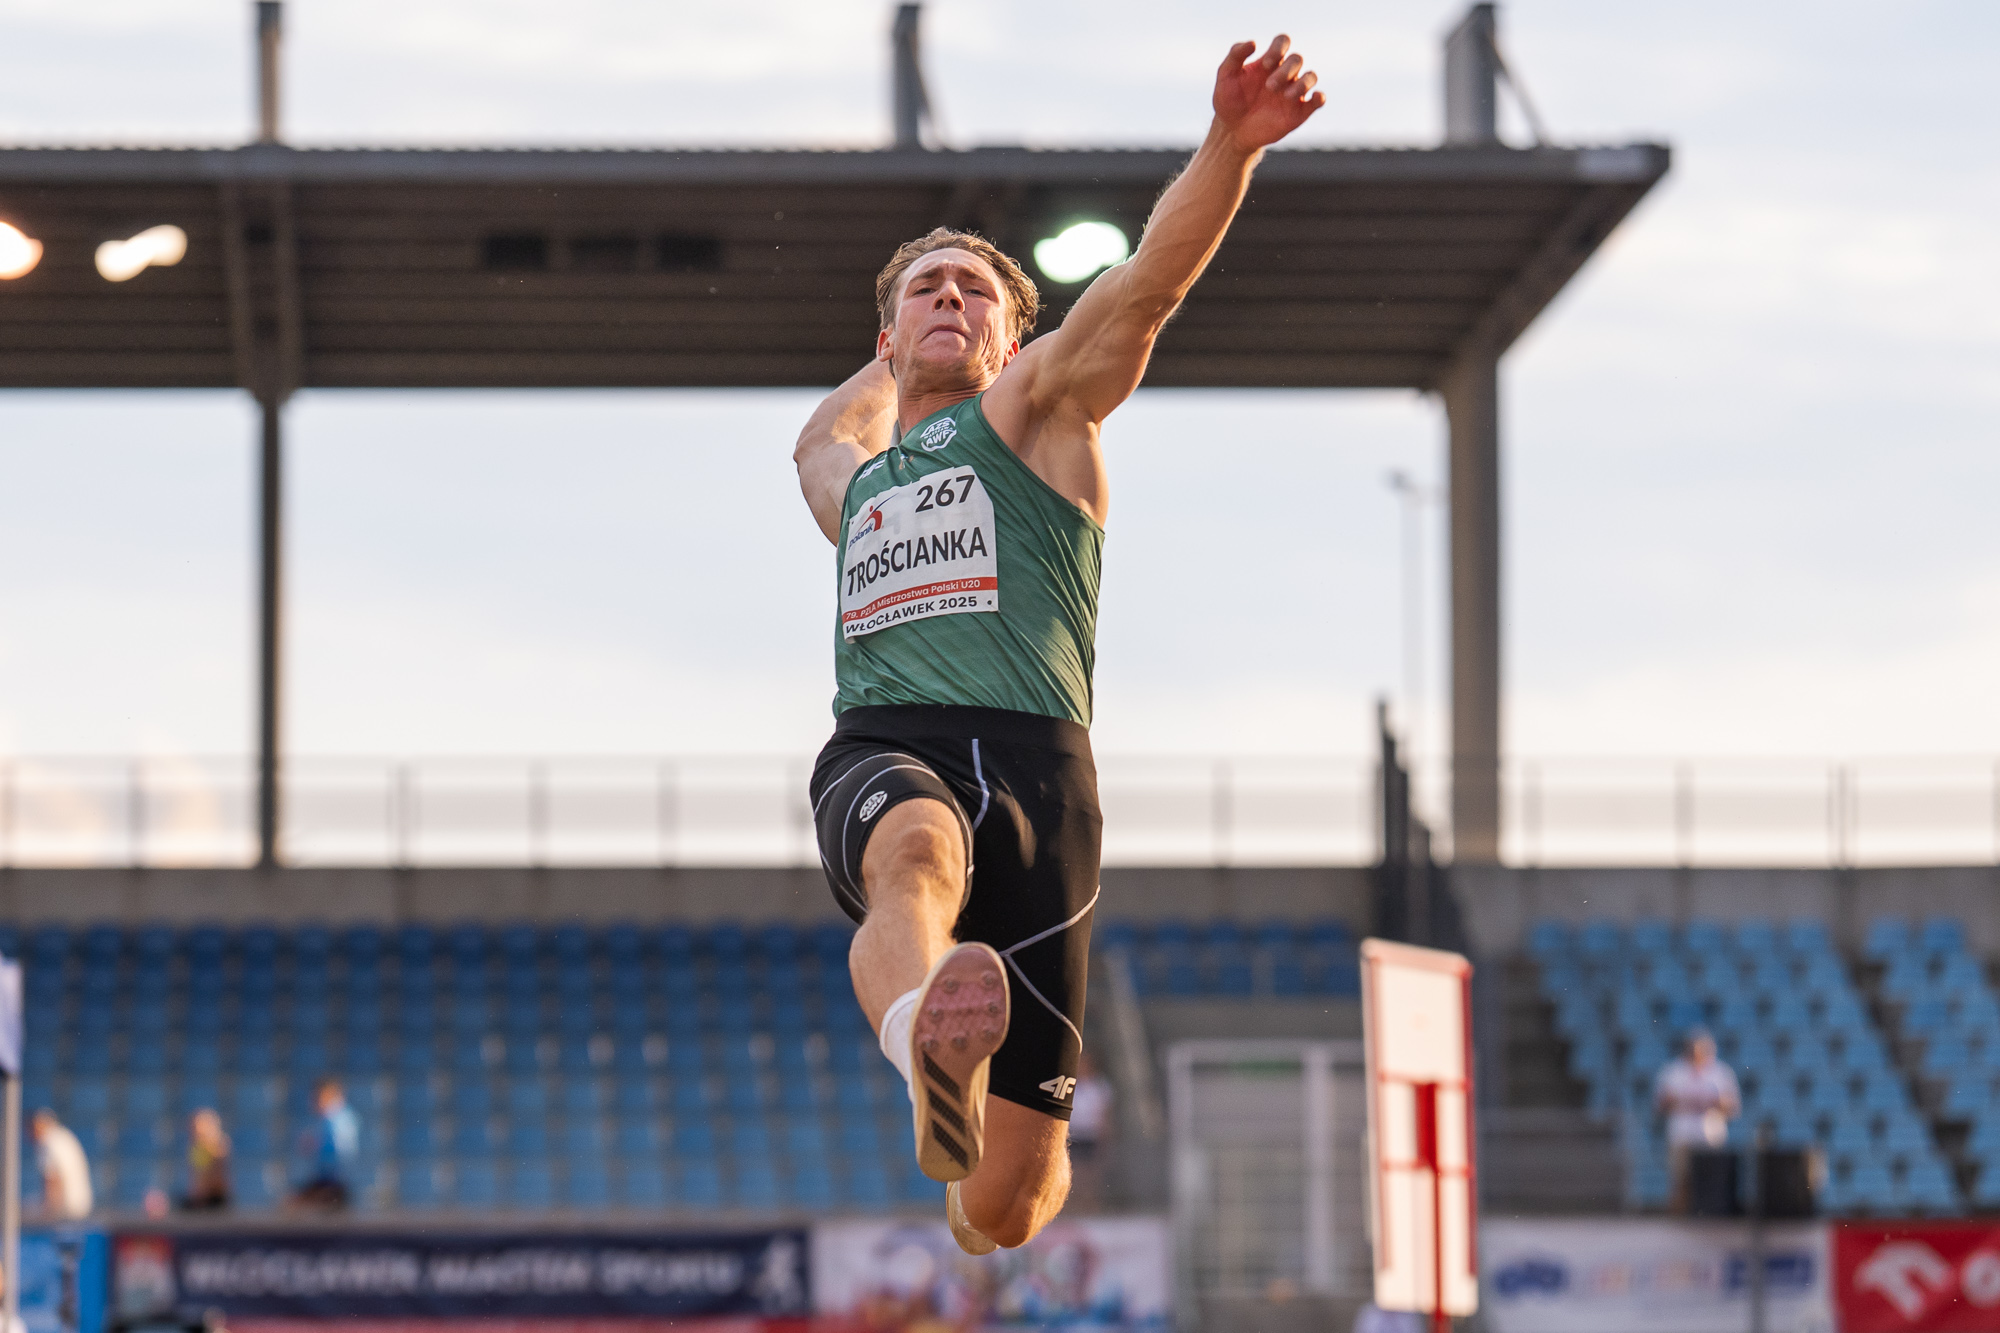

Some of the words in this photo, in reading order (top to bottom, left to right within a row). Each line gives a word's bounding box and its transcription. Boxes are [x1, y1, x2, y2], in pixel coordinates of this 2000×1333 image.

[926, 431, 949, 447] AWF
[928, 420, 950, 433] AZS
[915, 474, 975, 513] 267
[848, 522, 874, 551] polanik
[847, 526, 988, 596] TROŚCIANKA
[845, 611, 859, 620] 79.
[860, 604, 877, 618] PZLA
[876, 588, 929, 608] Mistrzostwa
[931, 580, 959, 594] Polski
[961, 579, 981, 589] U20
[845, 601, 935, 634] WŁOCŁAWEK
[939, 596, 978, 610] 2025
[1038, 1075, 1077, 1100] 4F
